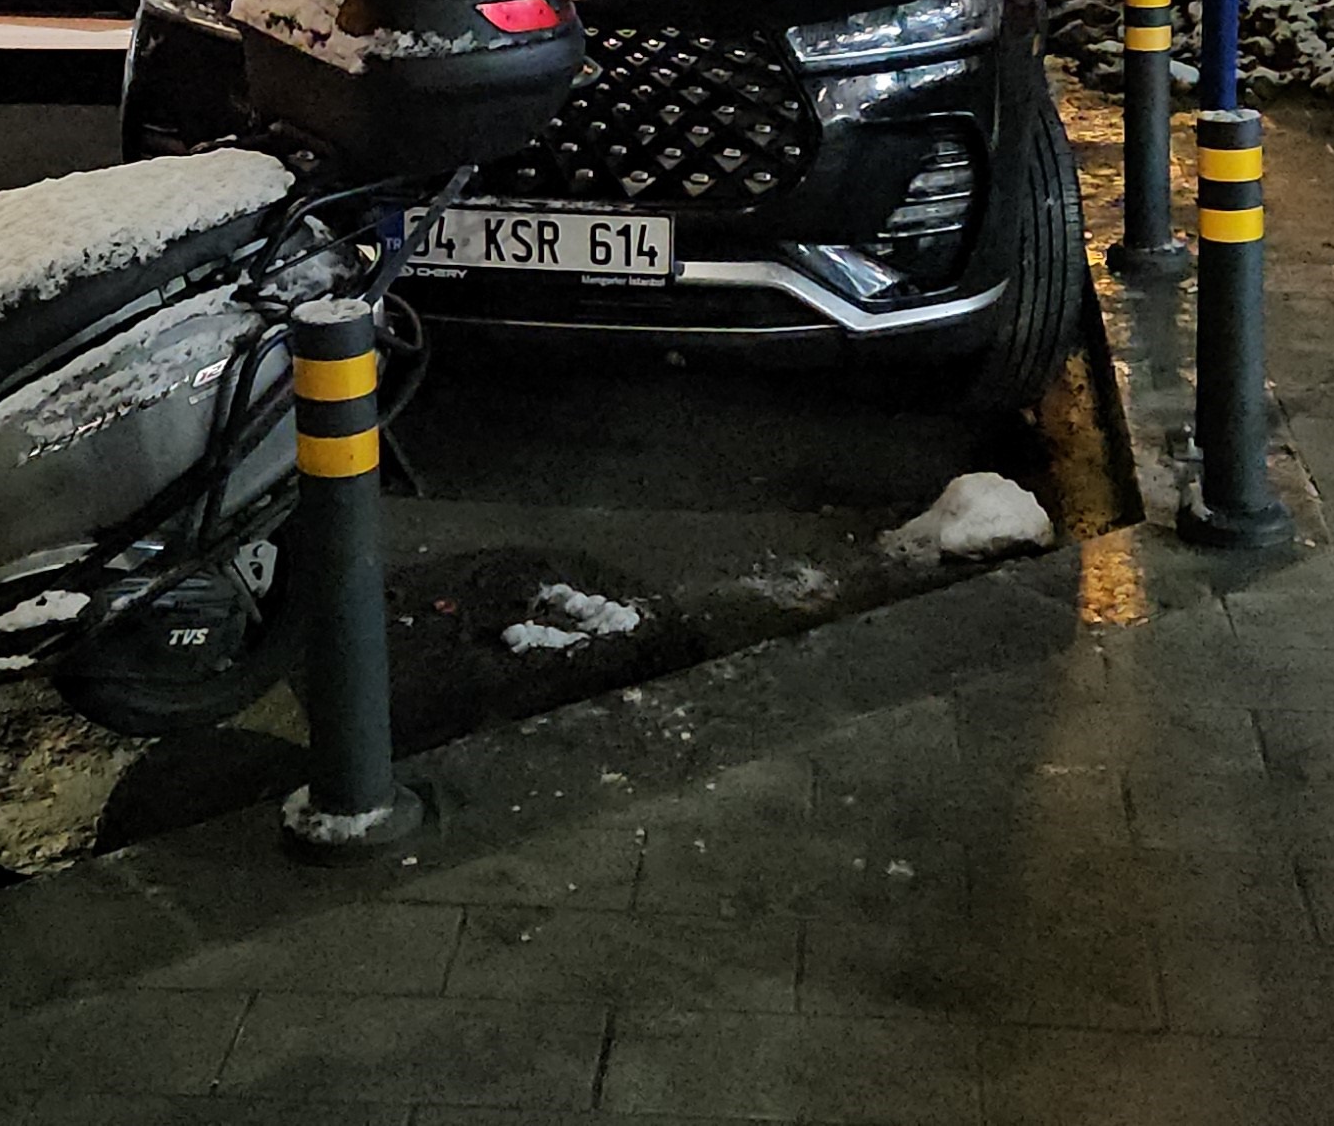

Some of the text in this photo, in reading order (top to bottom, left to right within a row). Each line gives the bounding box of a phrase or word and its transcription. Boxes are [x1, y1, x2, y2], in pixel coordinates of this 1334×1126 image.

[484, 218, 560, 265] KSR
[589, 222, 659, 268] 614
[169, 628, 209, 645] TVS
